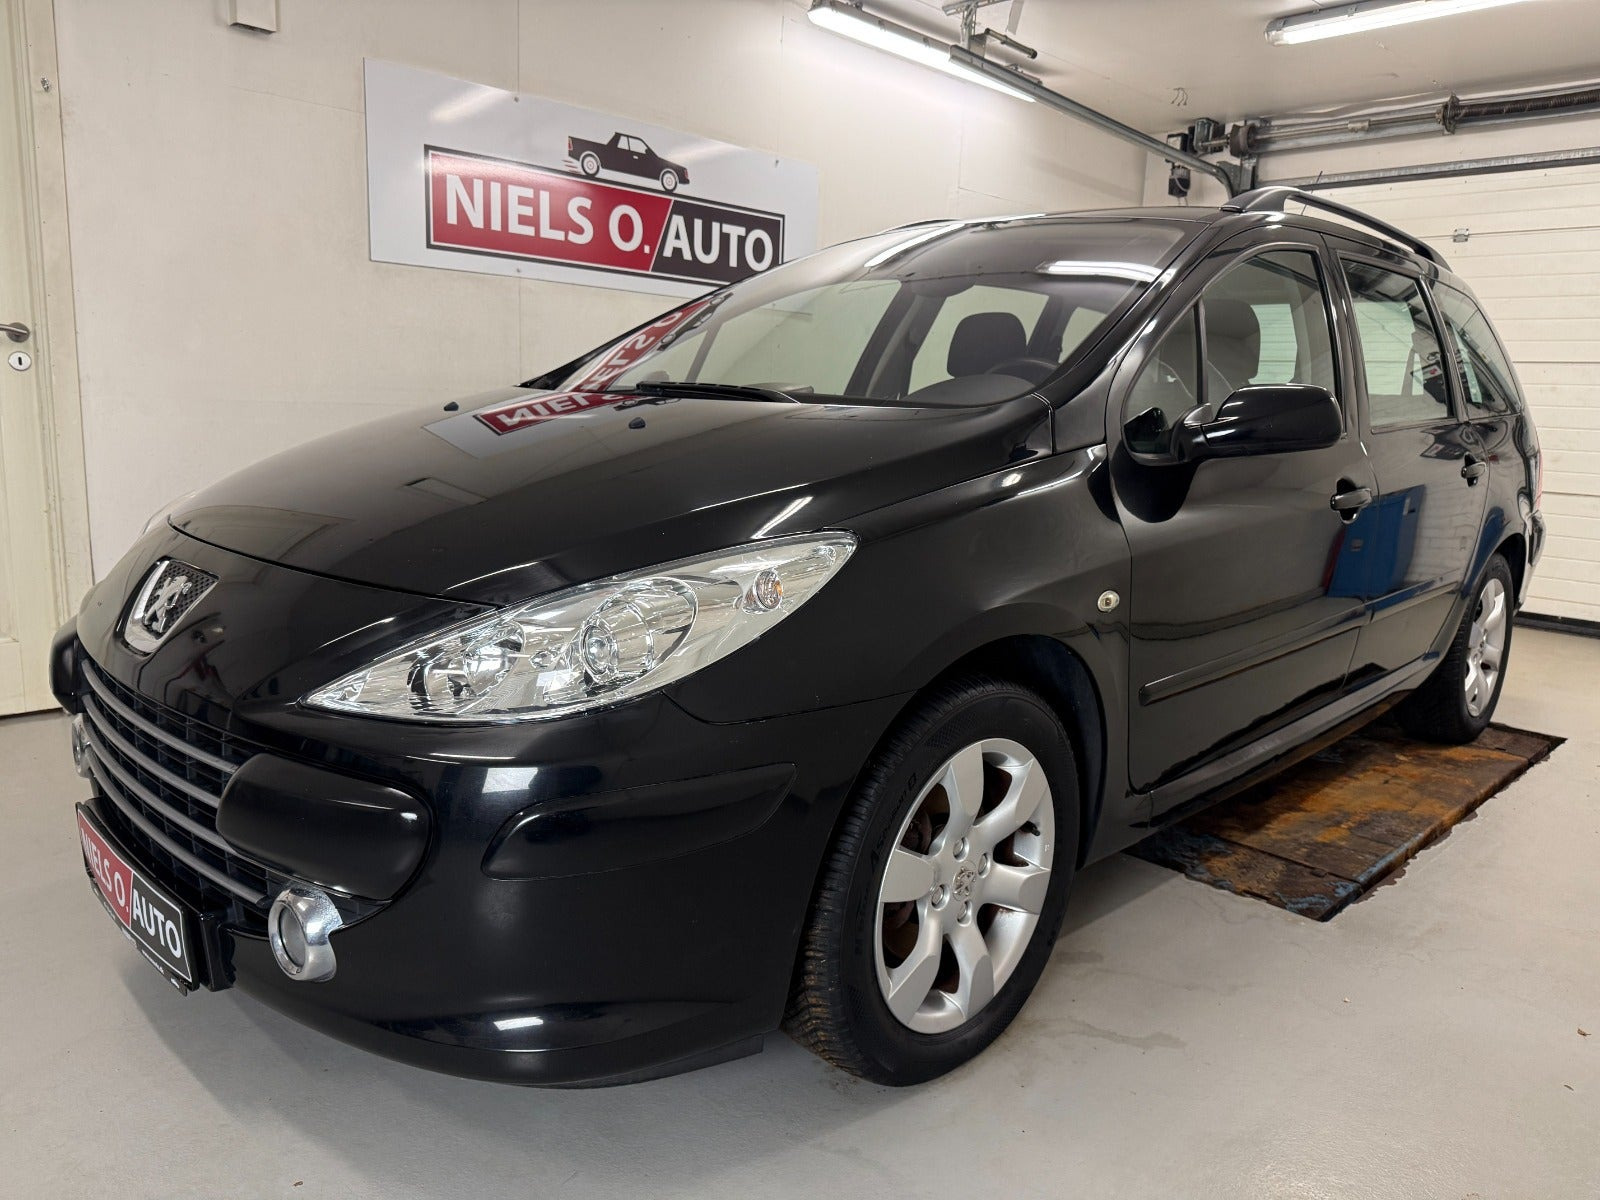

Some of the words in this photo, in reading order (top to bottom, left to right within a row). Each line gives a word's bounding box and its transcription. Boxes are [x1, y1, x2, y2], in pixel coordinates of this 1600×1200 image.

[445, 174, 594, 245] NIELS
[608, 204, 651, 254] O.
[662, 213, 774, 272] AUTO
[81, 828, 112, 892] NIELS
[114, 871, 129, 913] O.
[132, 888, 182, 959] AUTO
